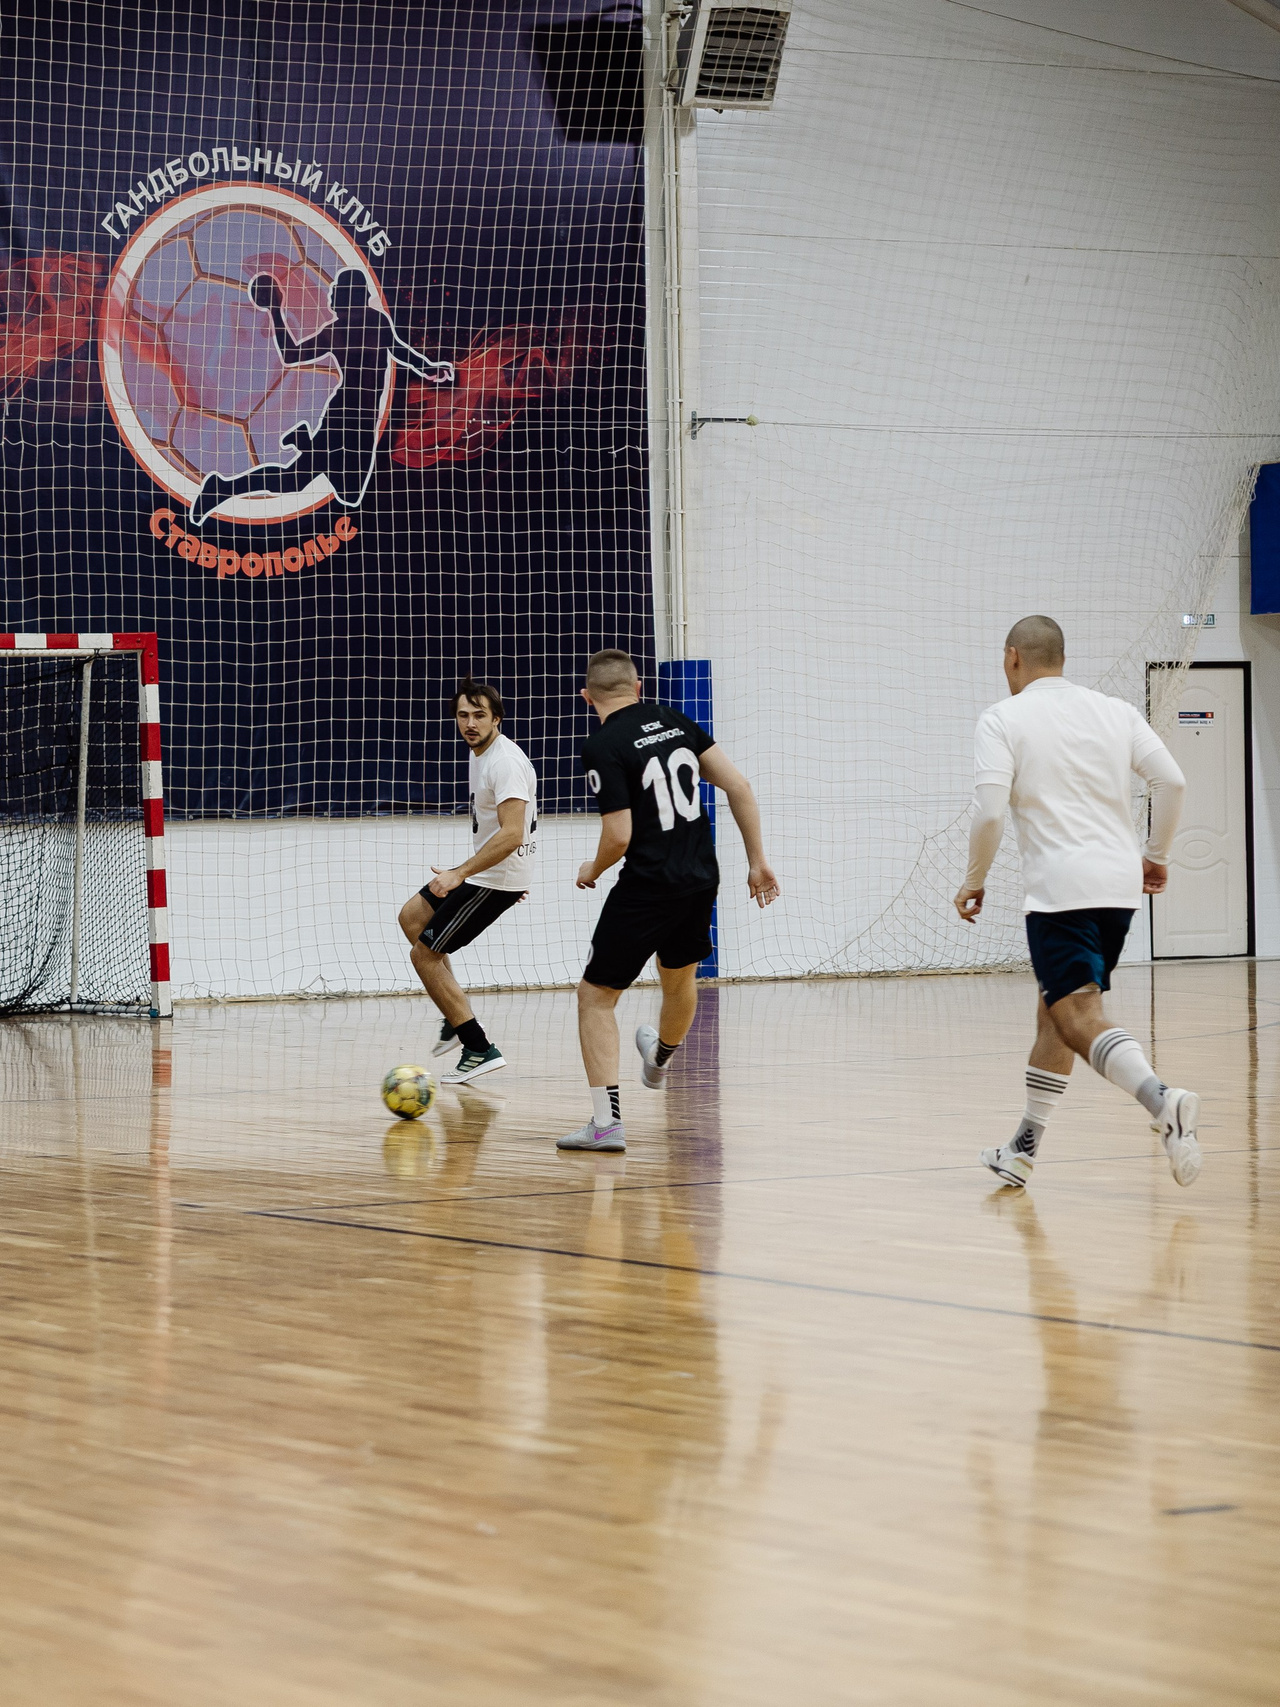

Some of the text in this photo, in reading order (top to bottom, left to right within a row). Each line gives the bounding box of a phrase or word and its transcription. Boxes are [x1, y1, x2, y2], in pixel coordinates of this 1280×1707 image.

[101, 147, 392, 257] ГАНДБОЛЬНЫЙ КЛУБ
[149, 508, 359, 579] Ставрополье
[642, 747, 700, 831] 10
